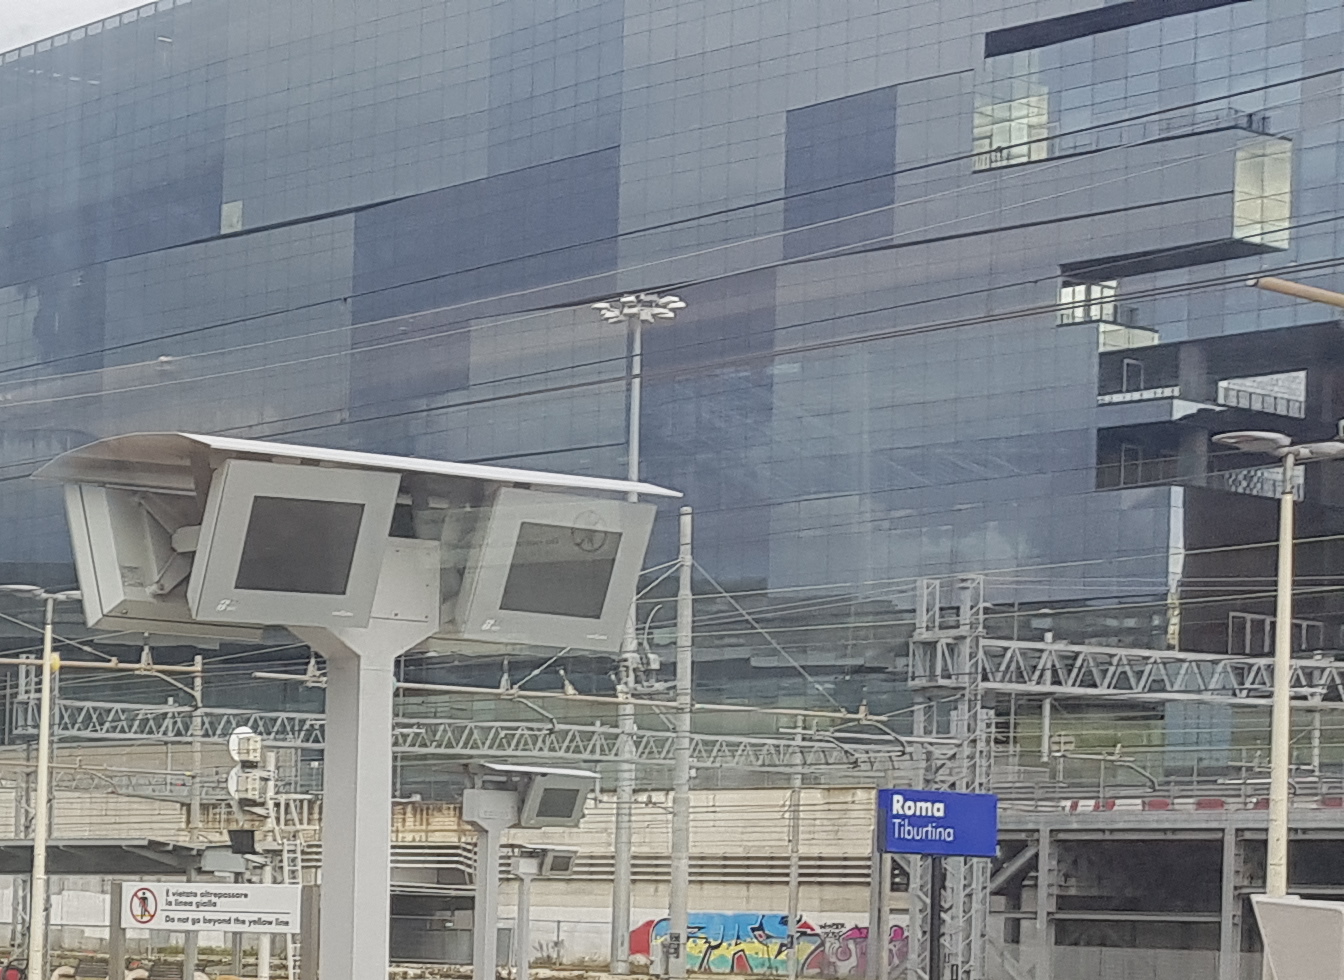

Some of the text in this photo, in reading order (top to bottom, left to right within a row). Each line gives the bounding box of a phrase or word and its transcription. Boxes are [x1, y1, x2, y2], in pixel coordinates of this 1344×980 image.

[892, 794, 945, 817] Roma
[892, 818, 954, 841] Tiburtina
[172, 890, 198, 898] vietato
[200, 890, 249, 899] oltrepassare
[165, 898, 217, 909] la linea gialla
[164, 915, 175, 923] Do
[191, 917, 201, 925] go
[203, 916, 232, 926] beyond
[233, 916, 246, 925] the
[248, 917, 273, 927] yellow
[275, 918, 290, 926] line
